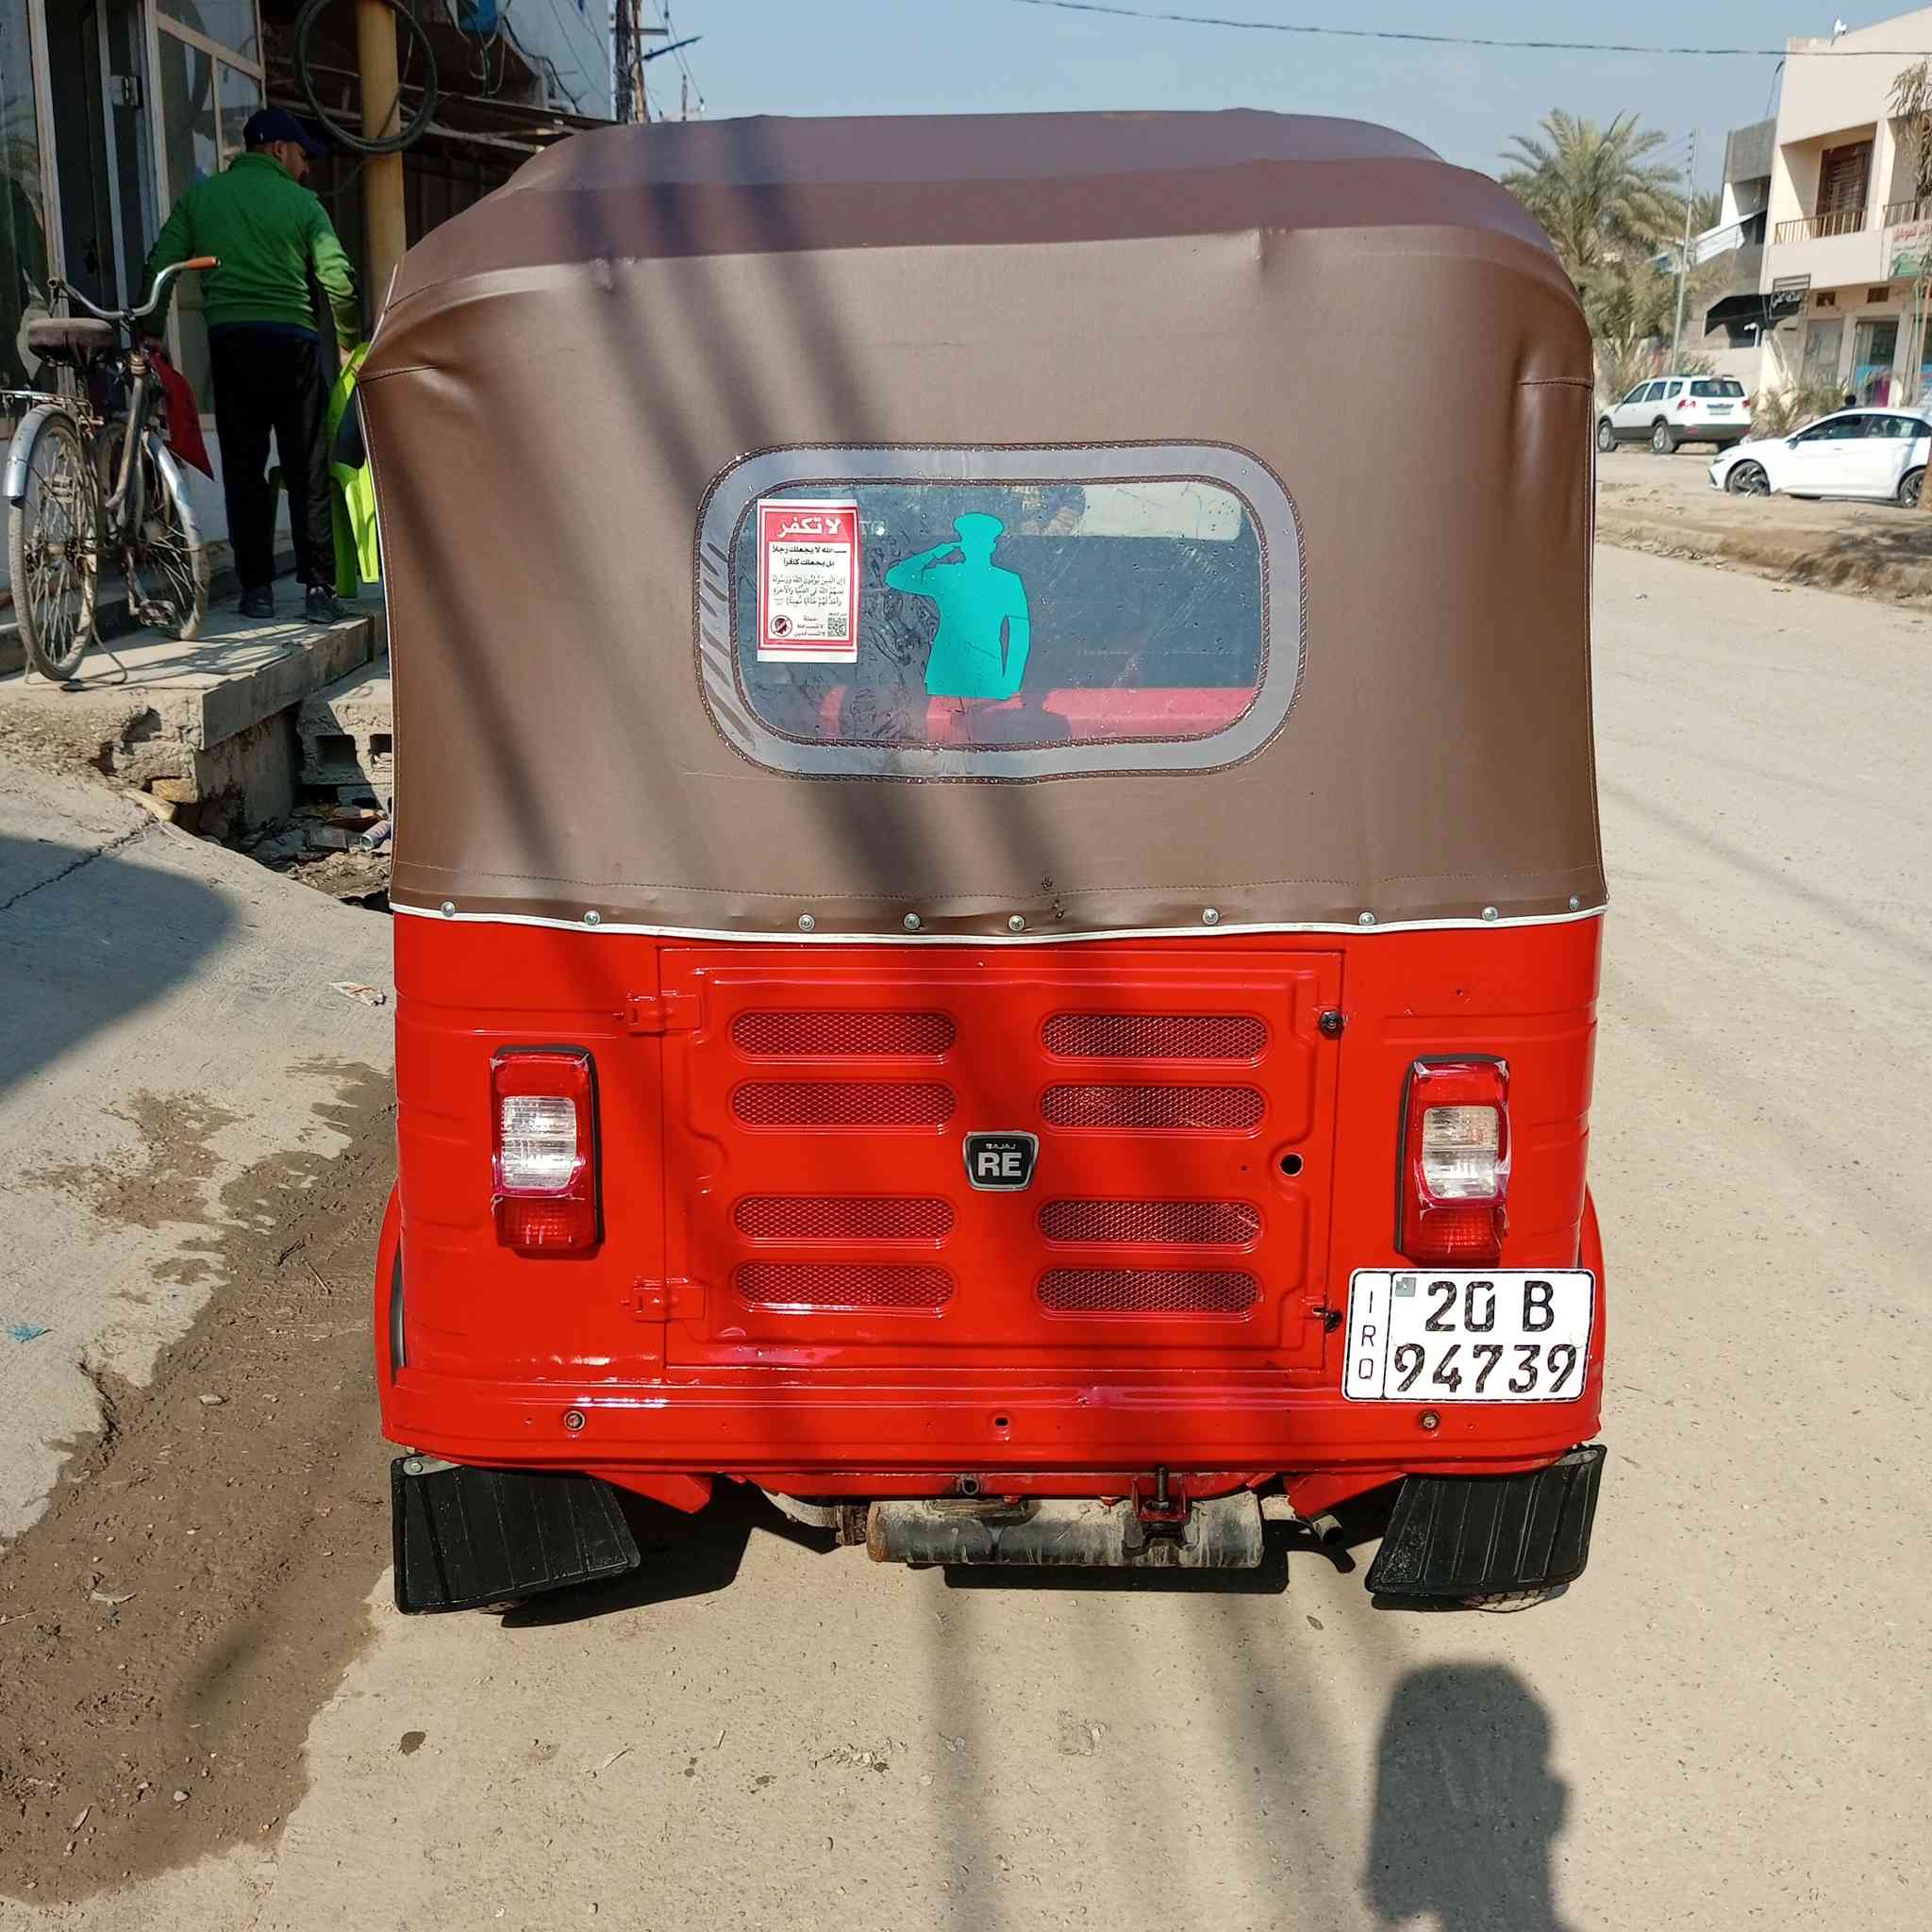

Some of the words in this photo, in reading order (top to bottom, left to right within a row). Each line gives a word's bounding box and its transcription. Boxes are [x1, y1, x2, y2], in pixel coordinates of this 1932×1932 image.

[777, 516, 823, 539] تكفر
[825, 517, 841, 535] لا
[977, 1152, 1023, 1177] RE
[1425, 1280, 1496, 1333] 20
[1522, 1280, 1555, 1332] B
[1393, 1343, 1577, 1393] 94739
